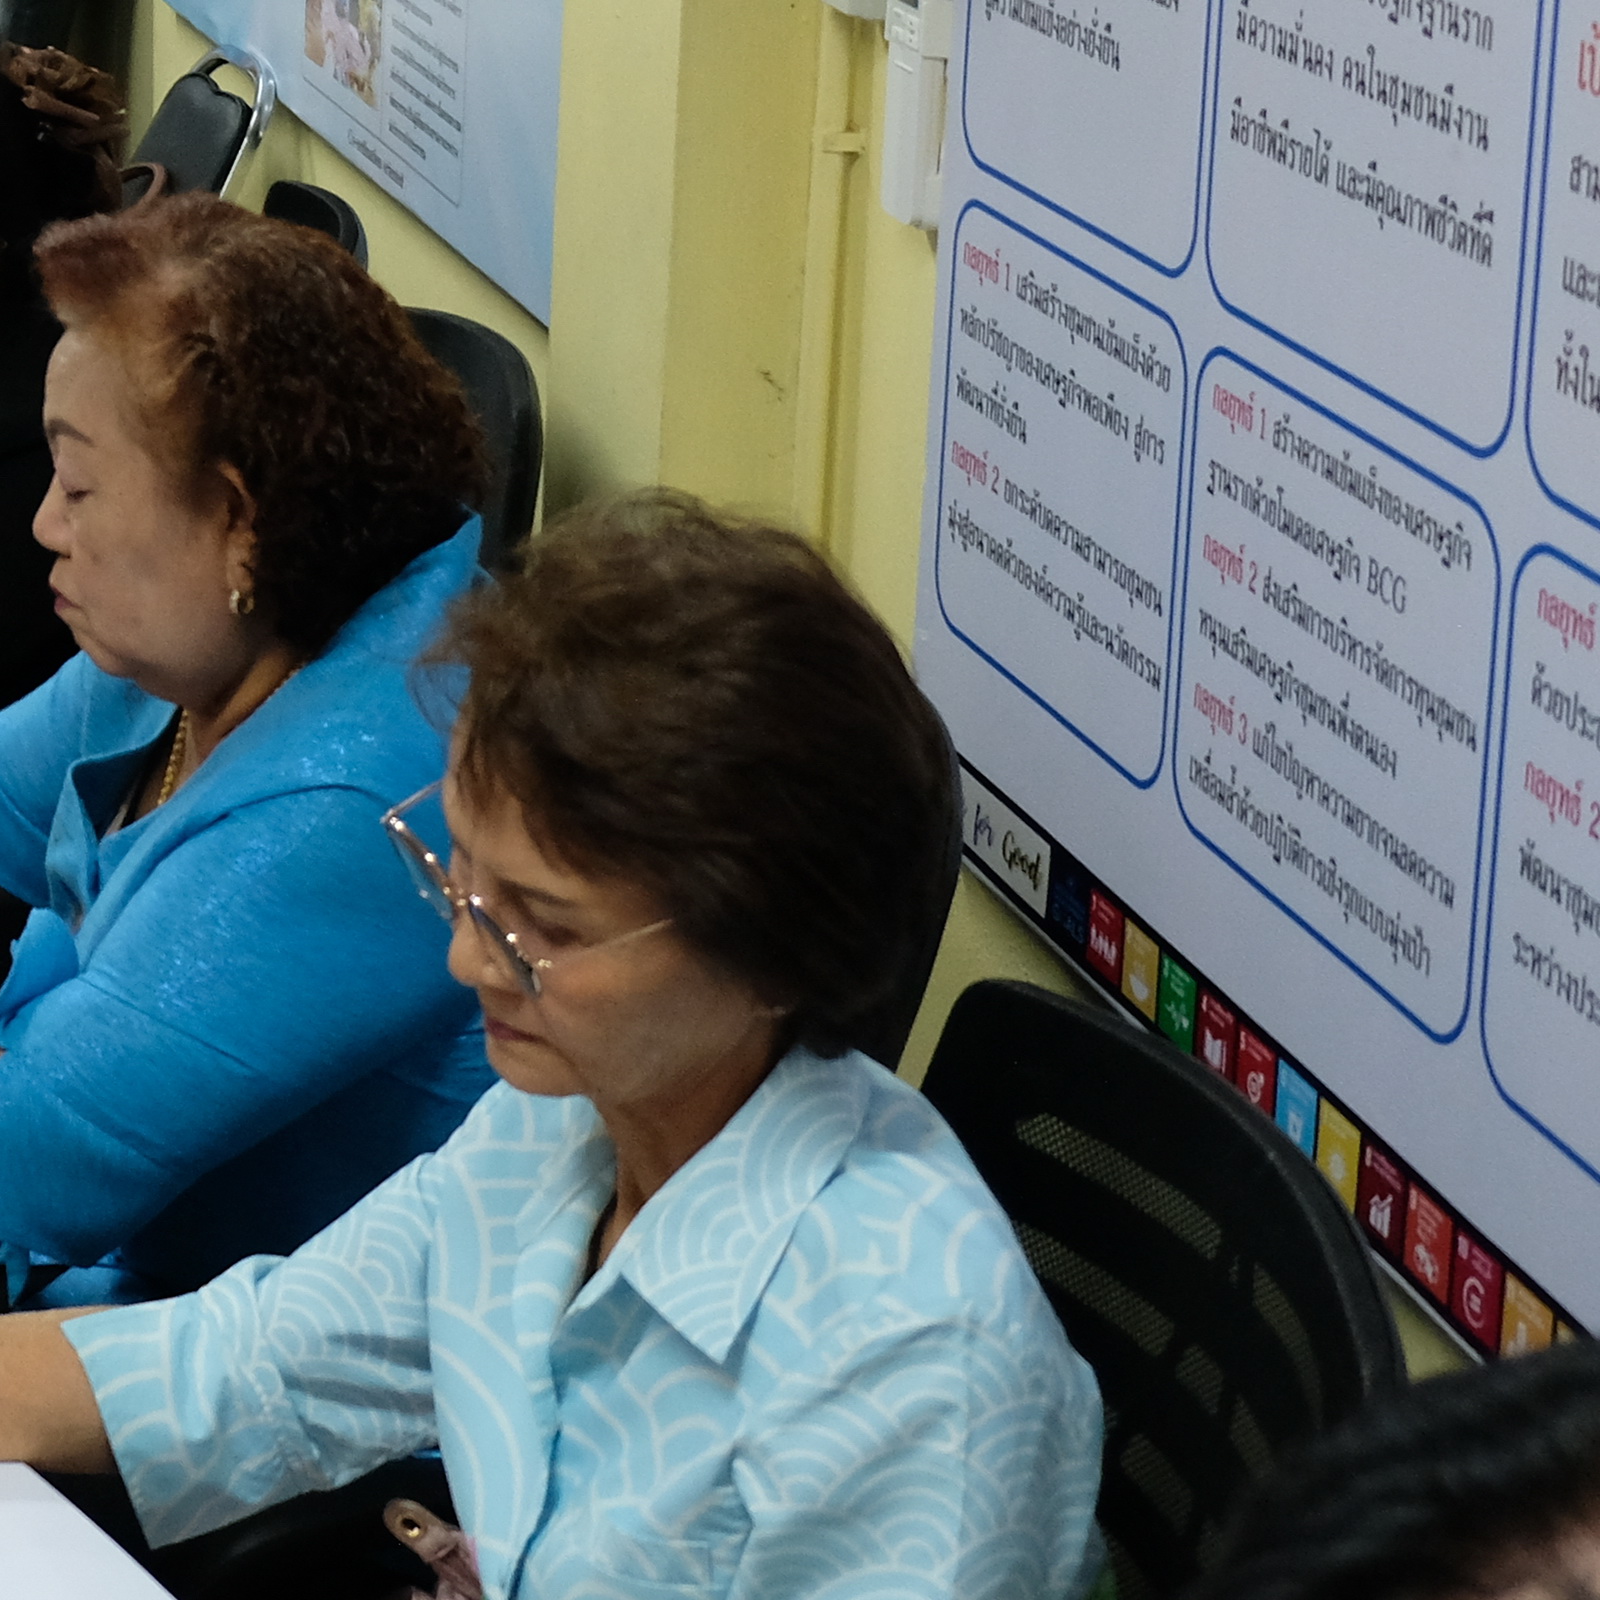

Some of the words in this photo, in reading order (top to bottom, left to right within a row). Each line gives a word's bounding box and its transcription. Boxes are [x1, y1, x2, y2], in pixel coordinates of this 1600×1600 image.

[1341, 44, 1490, 153] คนในชุมชนมีงาน
[1230, 97, 1331, 187] มีอาชีพมีรายได้
[1335, 157, 1495, 268] และมีคุณภาพชีวิตที่ดี
[962, 241, 1001, 287] กลยุทธ์
[1005, 261, 1010, 293] 1
[1212, 383, 1257, 435] กลยุทธ์
[1260, 406, 1267, 441] 1
[950, 440, 989, 487] กลยุทธ์
[991, 465, 1000, 496] 2
[1202, 533, 1247, 586] กลยุทธ์
[1248, 560, 1258, 596] 2
[1366, 554, 1408, 615] BCG
[1537, 586, 1597, 653] กลยุทธ์
[1193, 682, 1236, 736] กลยุทธ์
[1238, 712, 1248, 747] 3
[1522, 760, 1584, 827] กลยุทธ์
[1001, 830, 1044, 890] Good
